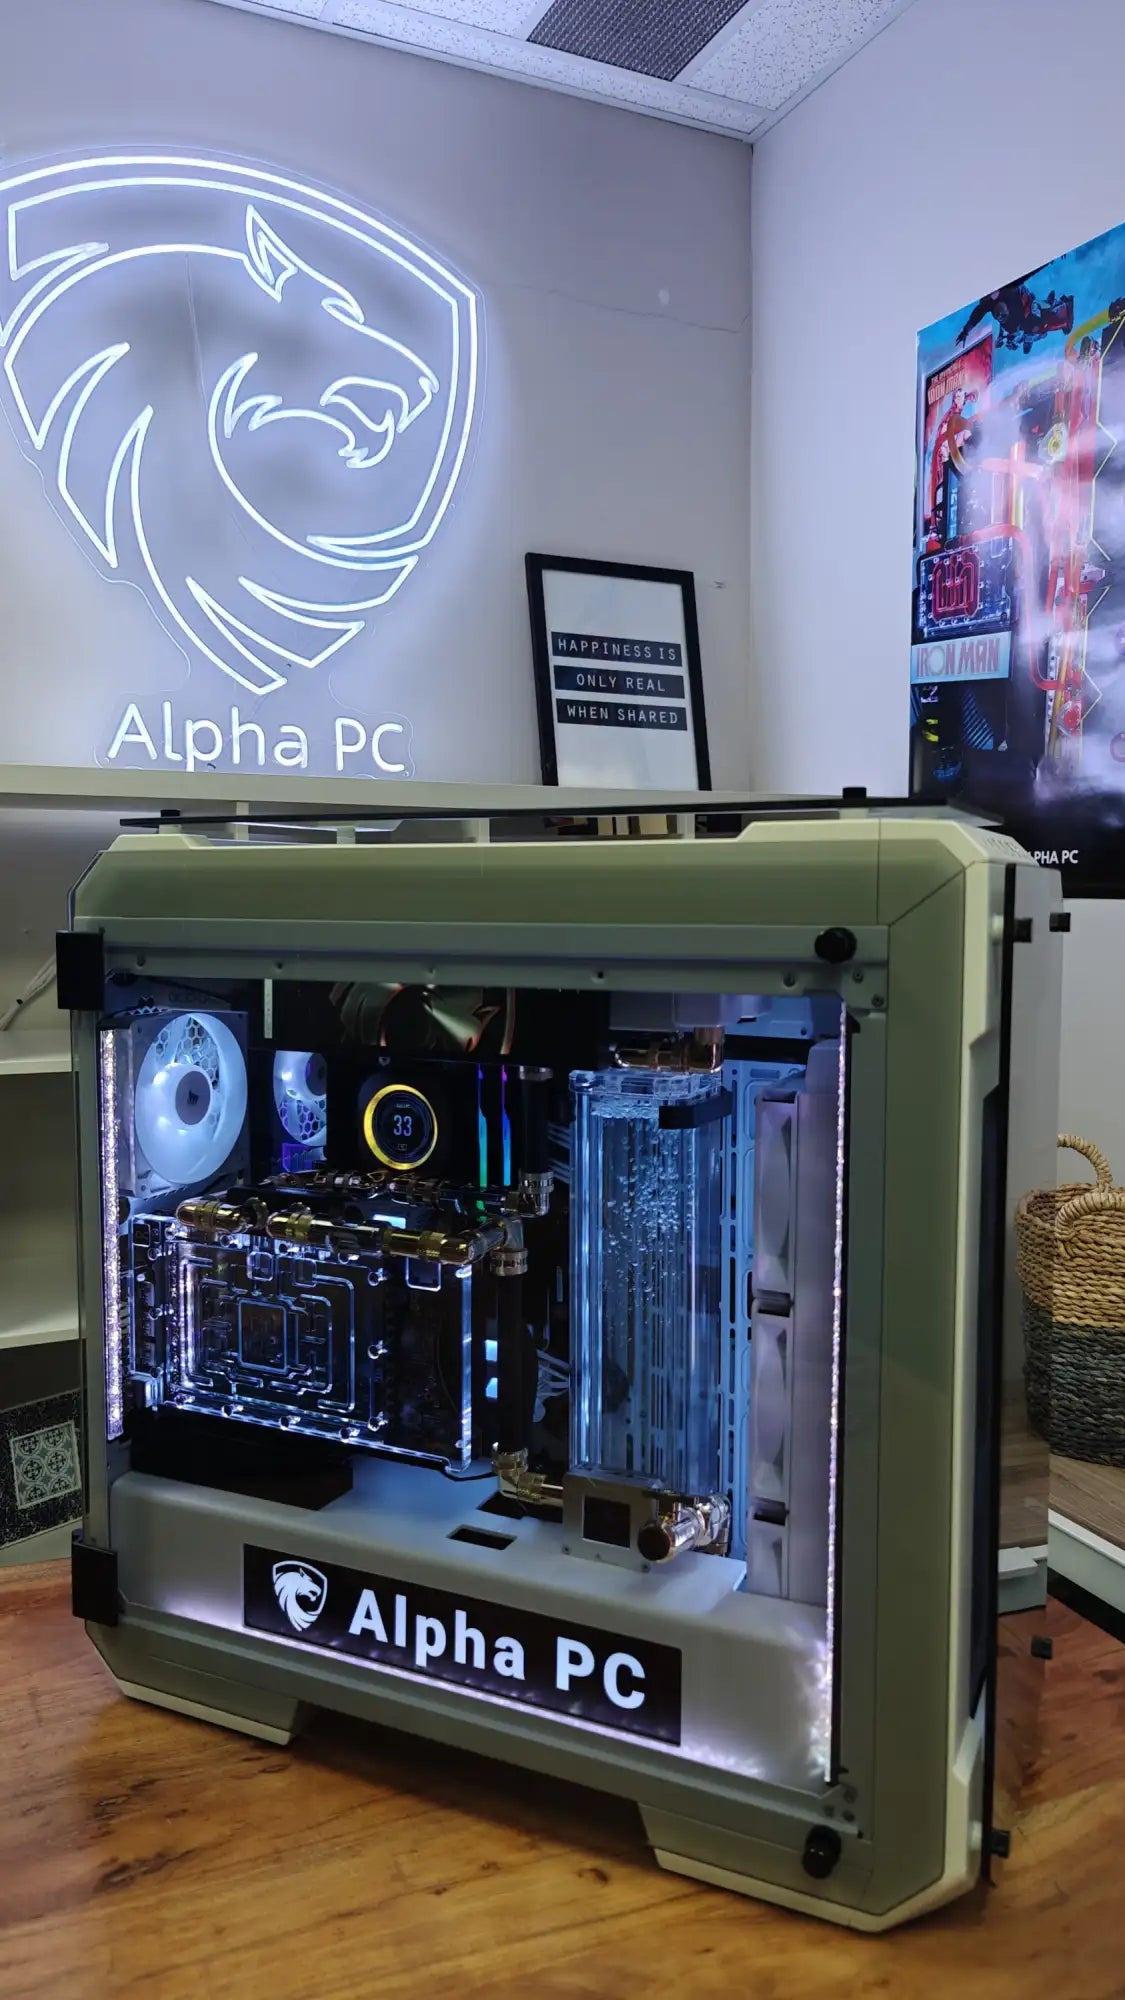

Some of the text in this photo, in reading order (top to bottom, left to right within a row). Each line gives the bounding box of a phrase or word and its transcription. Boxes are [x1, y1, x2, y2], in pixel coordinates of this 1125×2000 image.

[558, 638, 676, 660] HAPPINESS IS
[916, 638, 1000, 677] IRON MAN
[576, 673, 665, 692] ONLY REAL
[567, 705, 678, 724] WHEN SHARED
[107, 701, 405, 772] Alpha PC
[1028, 849, 1079, 864] PHA PC
[393, 1114, 412, 1136] 33
[348, 1588, 647, 1710] Alpha PC
